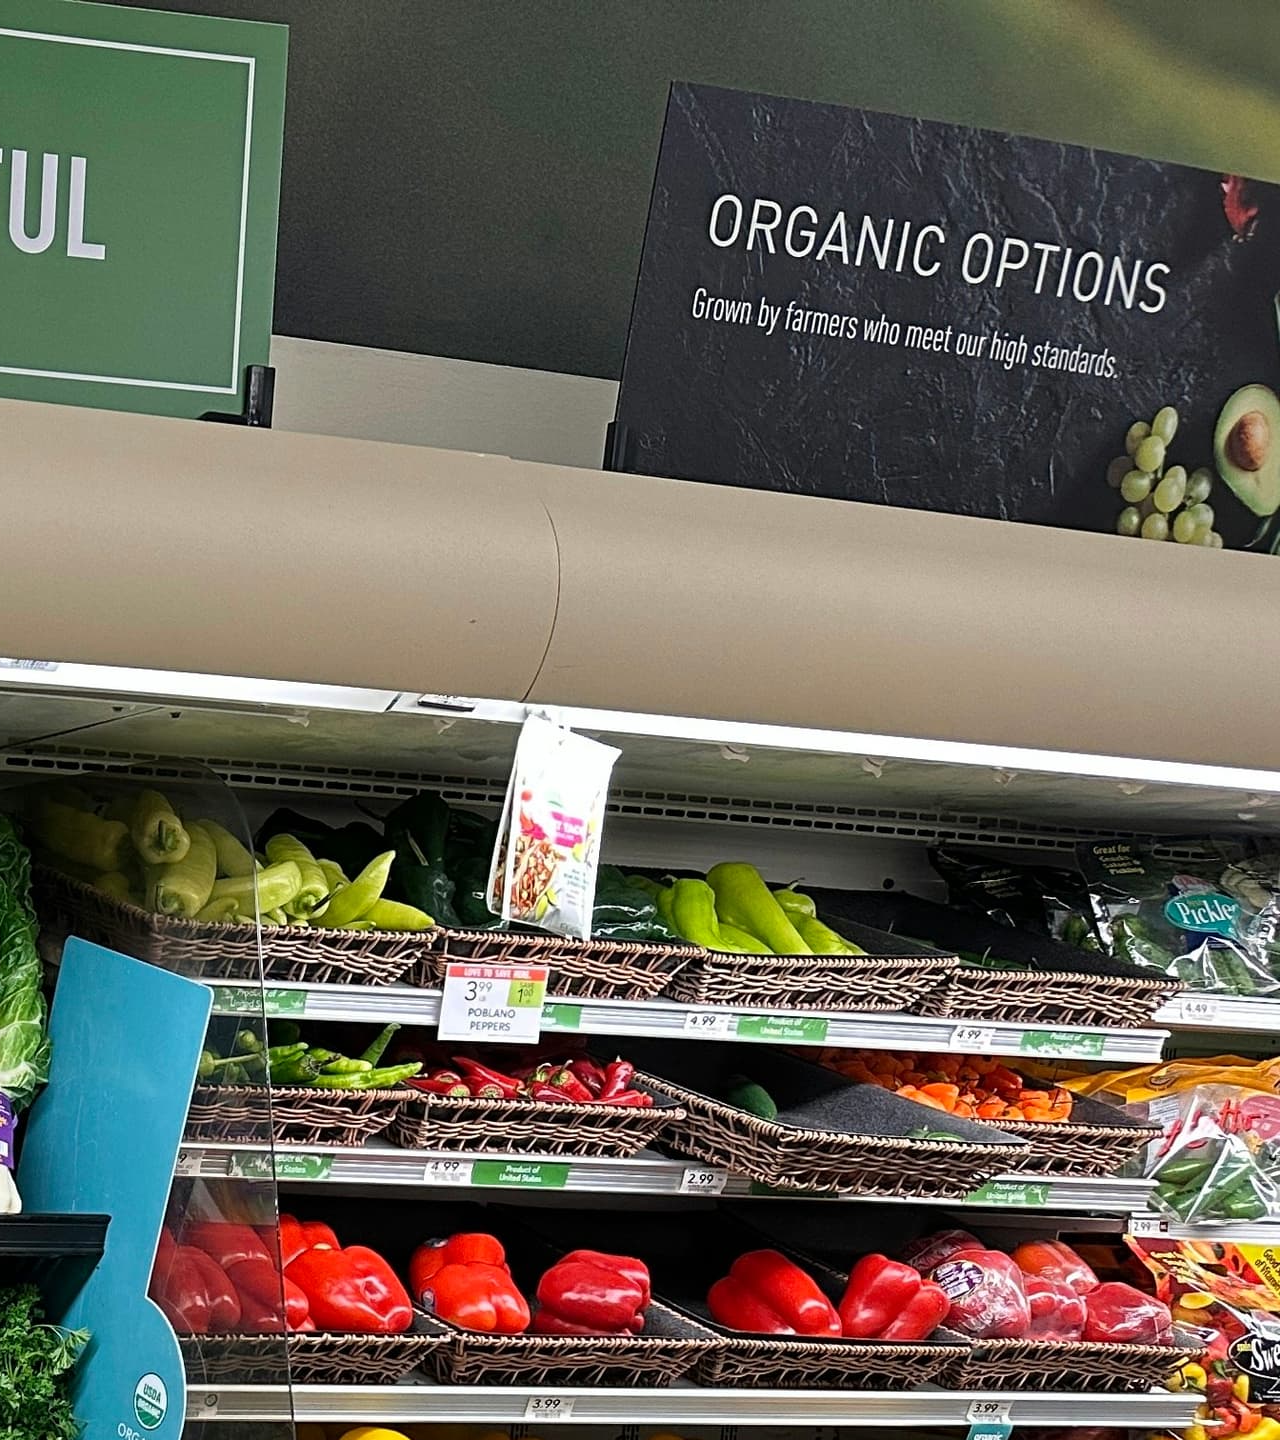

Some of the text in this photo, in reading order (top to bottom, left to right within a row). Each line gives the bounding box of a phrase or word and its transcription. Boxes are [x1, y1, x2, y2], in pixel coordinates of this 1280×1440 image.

[710, 195, 1169, 312] ORGANIC OPTIONS
[693, 288, 1119, 378] Grown by farmers who meet our high standards.
[463, 967, 482, 977] LOVE
[483, 968, 493, 977] TO
[495, 968, 511, 978] SAVE
[467, 1008, 516, 1019] POBLANO
[1185, 1003, 1208, 1013] 4.49
[469, 1021, 512, 1031] PEPPERS
[689, 1015, 716, 1026] 4.99
[767, 1016, 803, 1026] Product of
[760, 1026, 804, 1037] United States
[956, 1030, 981, 1039] 4.99
[505, 1164, 541, 1174] Product of
[499, 1172, 542, 1184] United States
[687, 1173, 714, 1185] 2.99
[993, 1182, 1027, 1193] Product of
[143, 1382, 162, 1404] USDA
[532, 1398, 561, 1409] 3.99
[973, 1402, 999, 1414] 3.99
